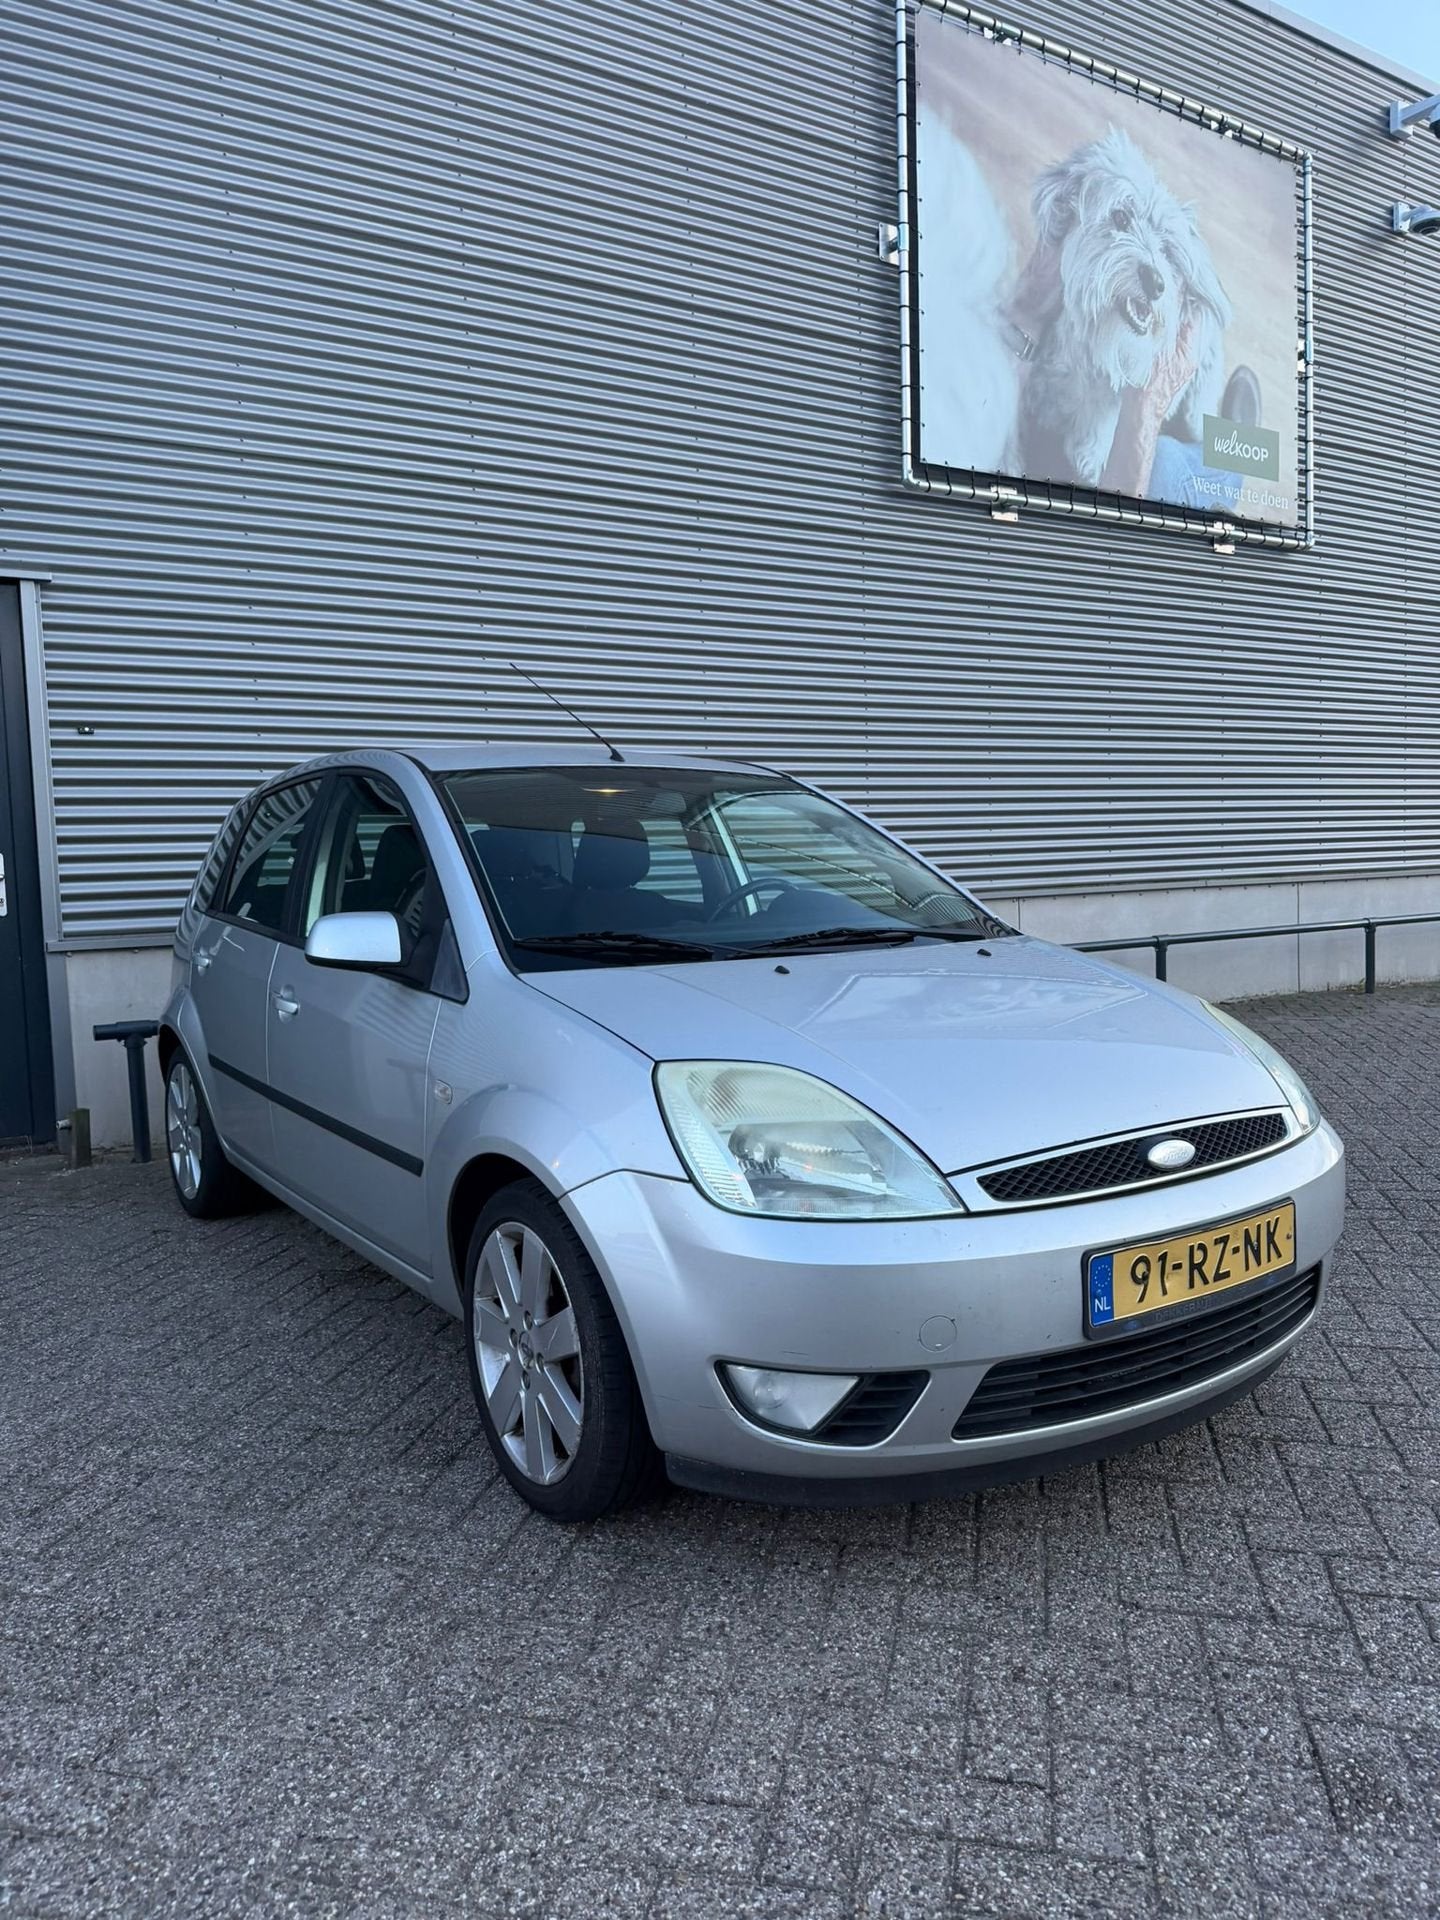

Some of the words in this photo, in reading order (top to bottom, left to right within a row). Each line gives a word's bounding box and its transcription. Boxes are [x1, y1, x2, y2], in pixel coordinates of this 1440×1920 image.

[1193, 475, 1222, 497] Weet
[1224, 484, 1245, 501] wat
[1247, 488, 1259, 503] te
[1261, 489, 1289, 509] doen
[1130, 1215, 1283, 1304] 91-RZ-NK
[1094, 1295, 1111, 1313] NL
